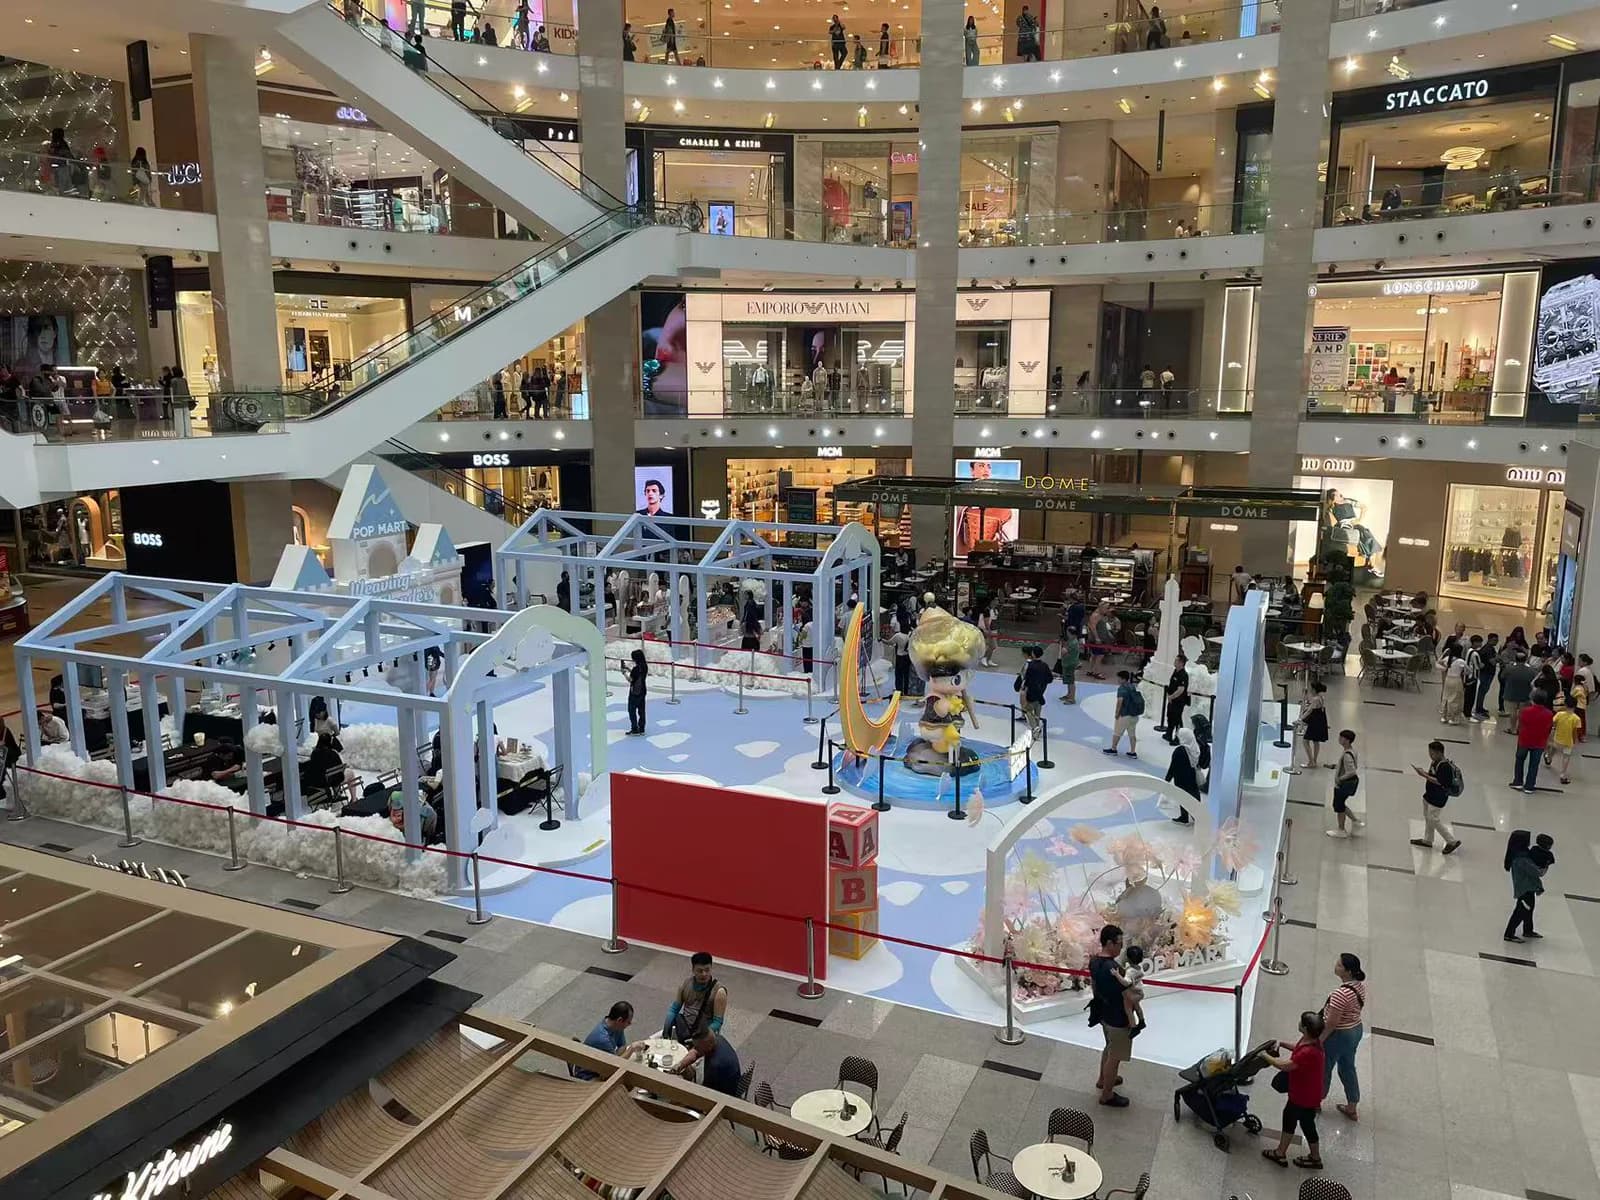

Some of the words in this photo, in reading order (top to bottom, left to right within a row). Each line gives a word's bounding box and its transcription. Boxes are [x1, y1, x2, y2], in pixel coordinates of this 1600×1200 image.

[1386, 80, 1488, 110] STACCATO
[679, 137, 720, 148] CHARLES
[735, 140, 761, 148] KEITH
[965, 202, 988, 212] SALE
[1383, 279, 1480, 296] LONGCHAMP
[747, 302, 804, 314] EMPORIO
[823, 302, 870, 314] ARMANI
[817, 446, 843, 458] MCM
[975, 447, 1002, 458] MCM
[473, 453, 510, 467] BOSS
[353, 525, 375, 539] POP
[377, 521, 407, 535] MART
[133, 532, 163, 547] BOSS
[351, 574, 413, 597] Weaving
[842, 878, 866, 905] B
[1172, 943, 1230, 971] MART
